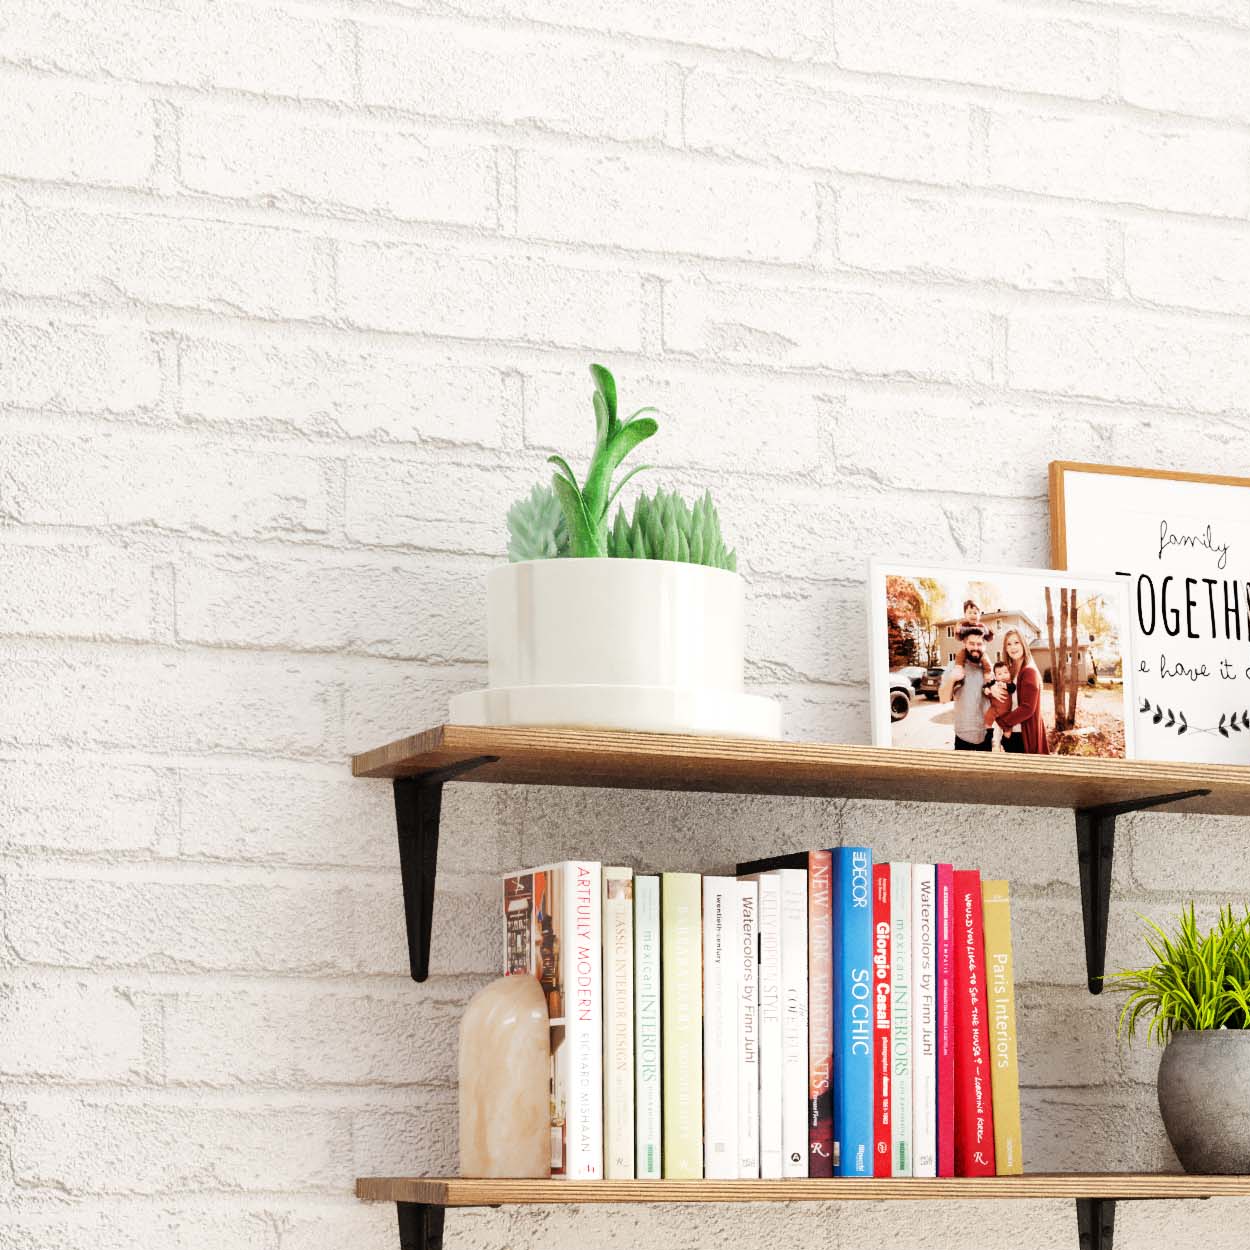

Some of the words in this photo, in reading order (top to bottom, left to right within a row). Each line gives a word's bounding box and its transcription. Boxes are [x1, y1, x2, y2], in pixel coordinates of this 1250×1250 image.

[1157, 520, 1230, 570] family
[1160, 653, 1211, 682] have
[1219, 657, 1237, 681] it
[576, 865, 592, 940] ARTFULLY
[812, 866, 829, 907] NEW
[963, 893, 974, 926] WOULD
[742, 896, 754, 982] Watercolors
[812, 914, 829, 963] YORK
[920, 881, 932, 969] Watercolors
[965, 928, 974, 944] YOU
[643, 930, 653, 991] mexican
[873, 921, 890, 980] Giorgio
[896, 918, 905, 982] mexican
[992, 953, 1009, 993] Paris
[577, 945, 592, 1020] MODERN
[616, 958, 627, 1019] INTERIOR
[742, 985, 755, 1002] by
[851, 967, 869, 1000] SO
[920, 973, 933, 991] by
[968, 971, 977, 986] TO
[744, 1005, 756, 1034] Finn
[763, 983, 778, 1024] STYLE
[876, 982, 890, 1029] Casali
[921, 994, 933, 1023] Finn
[971, 1006, 980, 1026] THE
[616, 1022, 627, 1072] DESIGN
[640, 993, 657, 1083] INTERIORS
[744, 1035, 756, 1064] Juhl
[812, 974, 830, 1089] APARTMENTS
[851, 1003, 870, 1056] CHIC
[895, 984, 909, 1077] INTERIORS
[922, 1025, 934, 1056] Juhl
[994, 998, 1012, 1069] Interiors
[580, 1032, 591, 1087] RICHARD
[579, 1091, 591, 1152] MISHAAN
